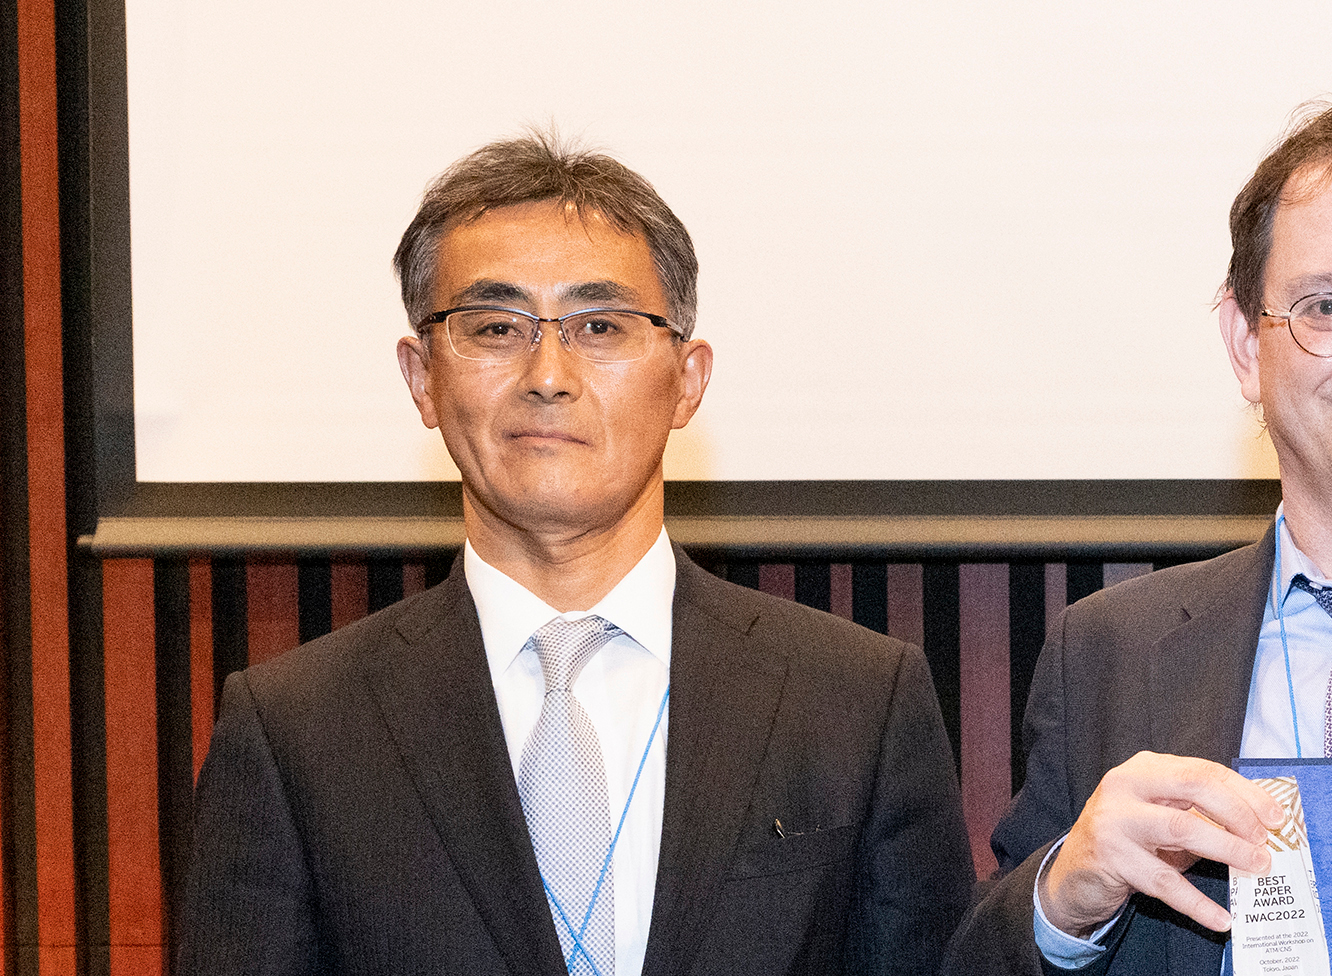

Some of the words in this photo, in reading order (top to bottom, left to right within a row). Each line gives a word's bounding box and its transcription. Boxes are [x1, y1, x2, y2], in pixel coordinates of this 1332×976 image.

[1257, 875, 1286, 886] BEST
[1254, 886, 1292, 897] PAPER
[1253, 896, 1295, 907] AWARD
[1245, 909, 1305, 923] IWAC2022
[1242, 940, 1278, 949] International
[1278, 938, 1305, 946] Workshop
[1246, 934, 1275, 942] Presented
[1281, 964, 1299, 972] Japan
